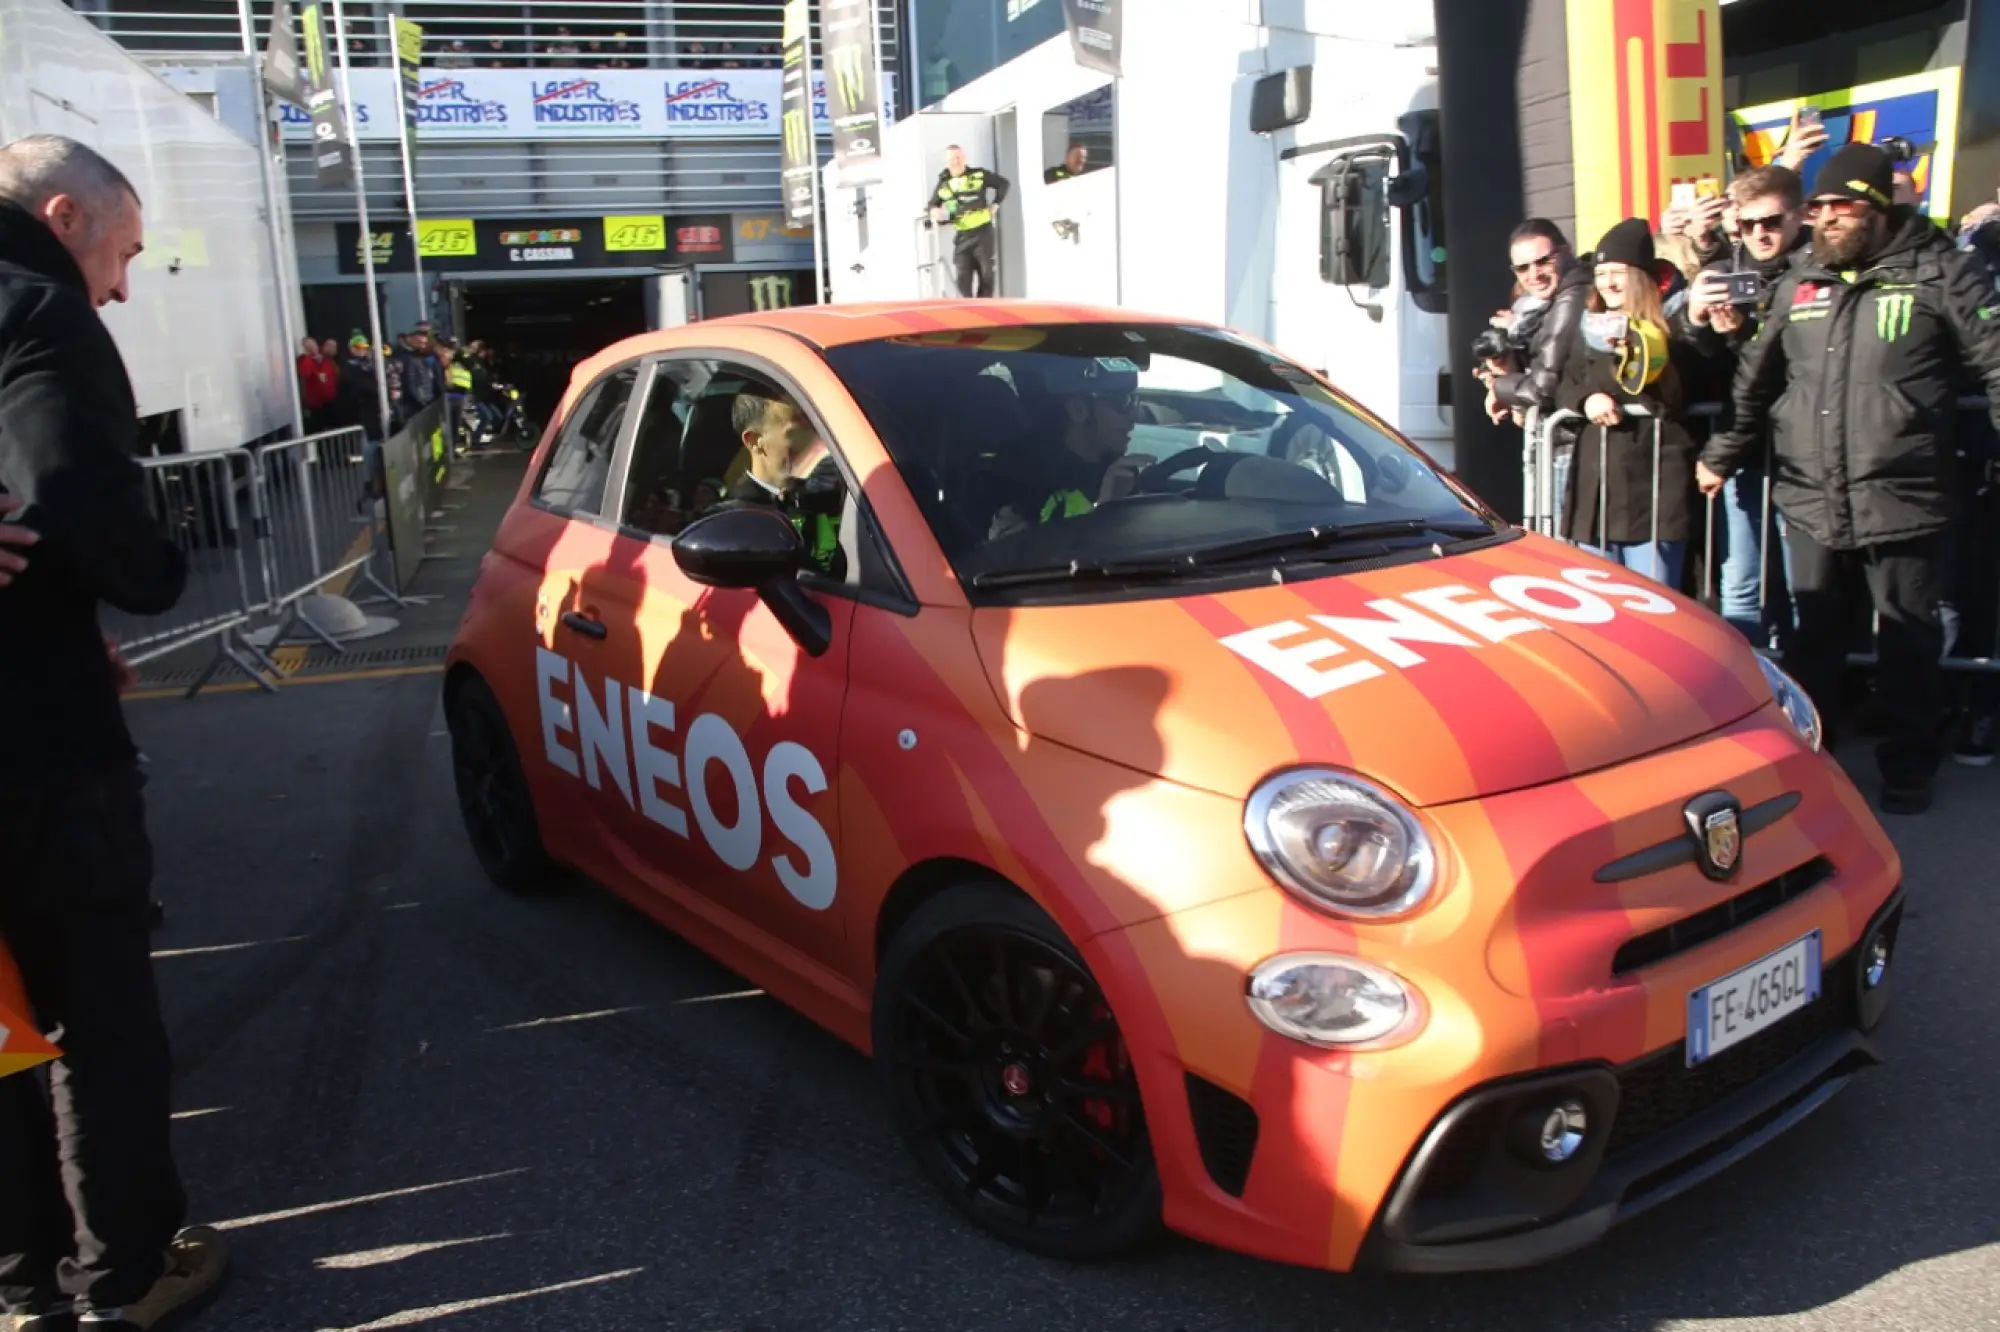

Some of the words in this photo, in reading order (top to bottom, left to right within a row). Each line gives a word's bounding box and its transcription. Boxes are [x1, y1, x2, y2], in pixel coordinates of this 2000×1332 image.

[532, 78, 607, 103] LASER
[664, 78, 737, 103] LASER
[534, 101, 641, 122] INDUSTRIES
[667, 101, 769, 122] INDUSTRIES
[419, 229, 470, 252] 46
[609, 224, 660, 247] 46
[1218, 568, 1676, 698] ENEOS
[536, 645, 838, 911] ENEOS
[1712, 987, 1738, 1040] FE
[1744, 956, 1805, 1022] 465GL
